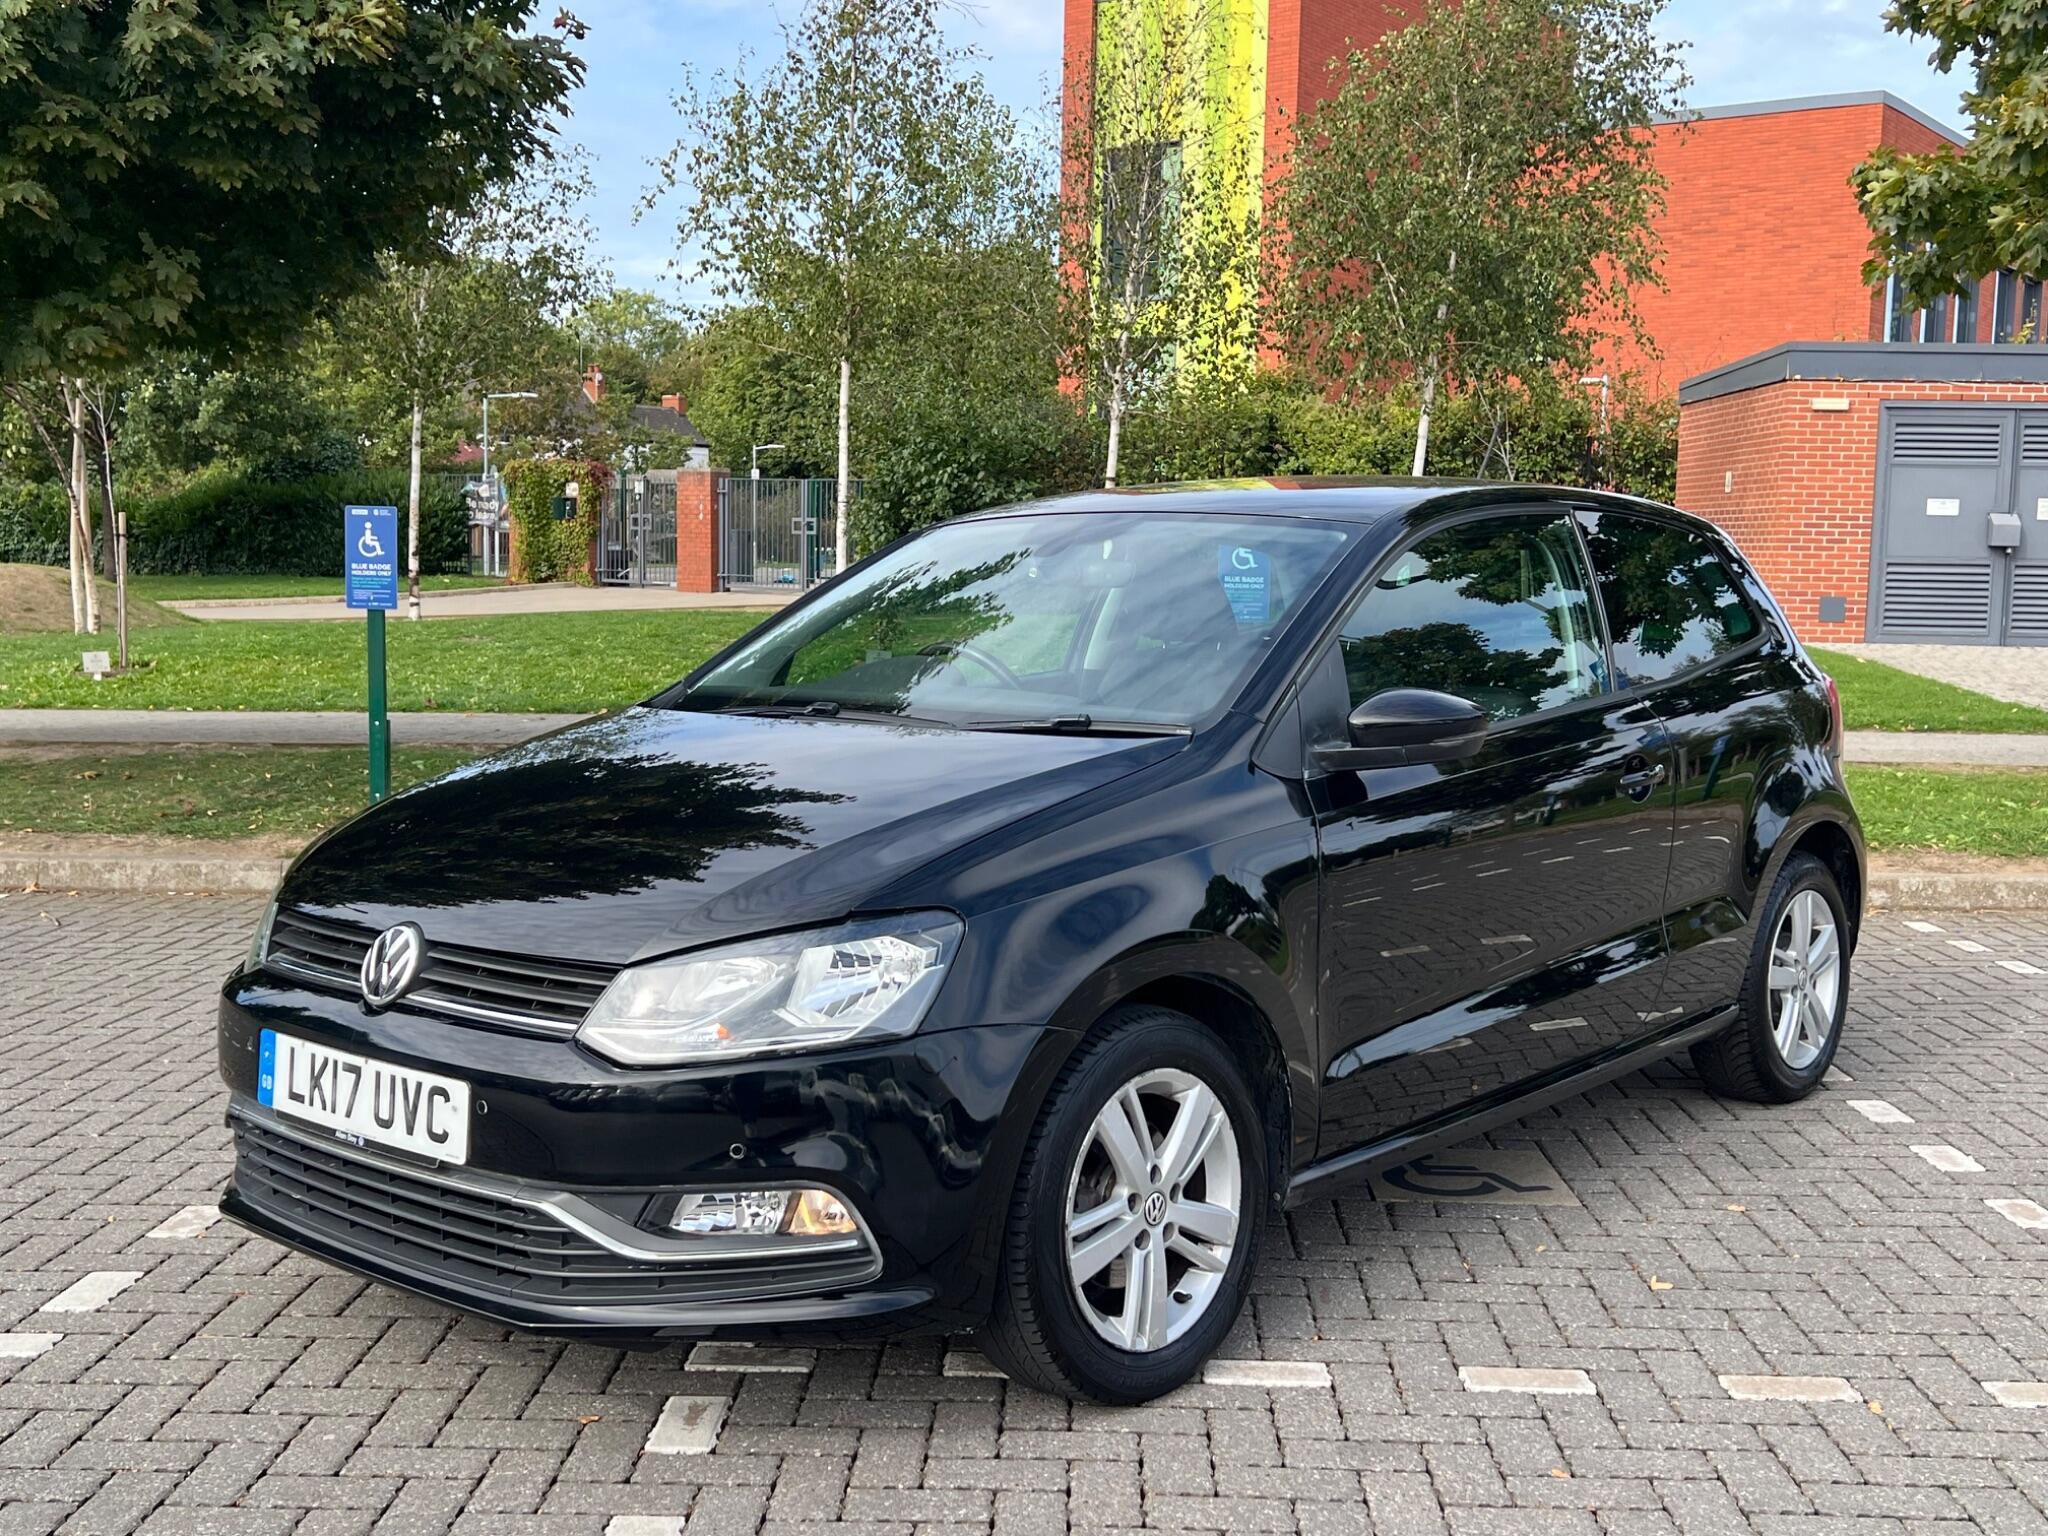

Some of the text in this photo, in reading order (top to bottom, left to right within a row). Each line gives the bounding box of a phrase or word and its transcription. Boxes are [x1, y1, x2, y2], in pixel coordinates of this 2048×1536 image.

[369, 563, 392, 571] BADGE
[288, 1046, 451, 1144] LK17 UVC
